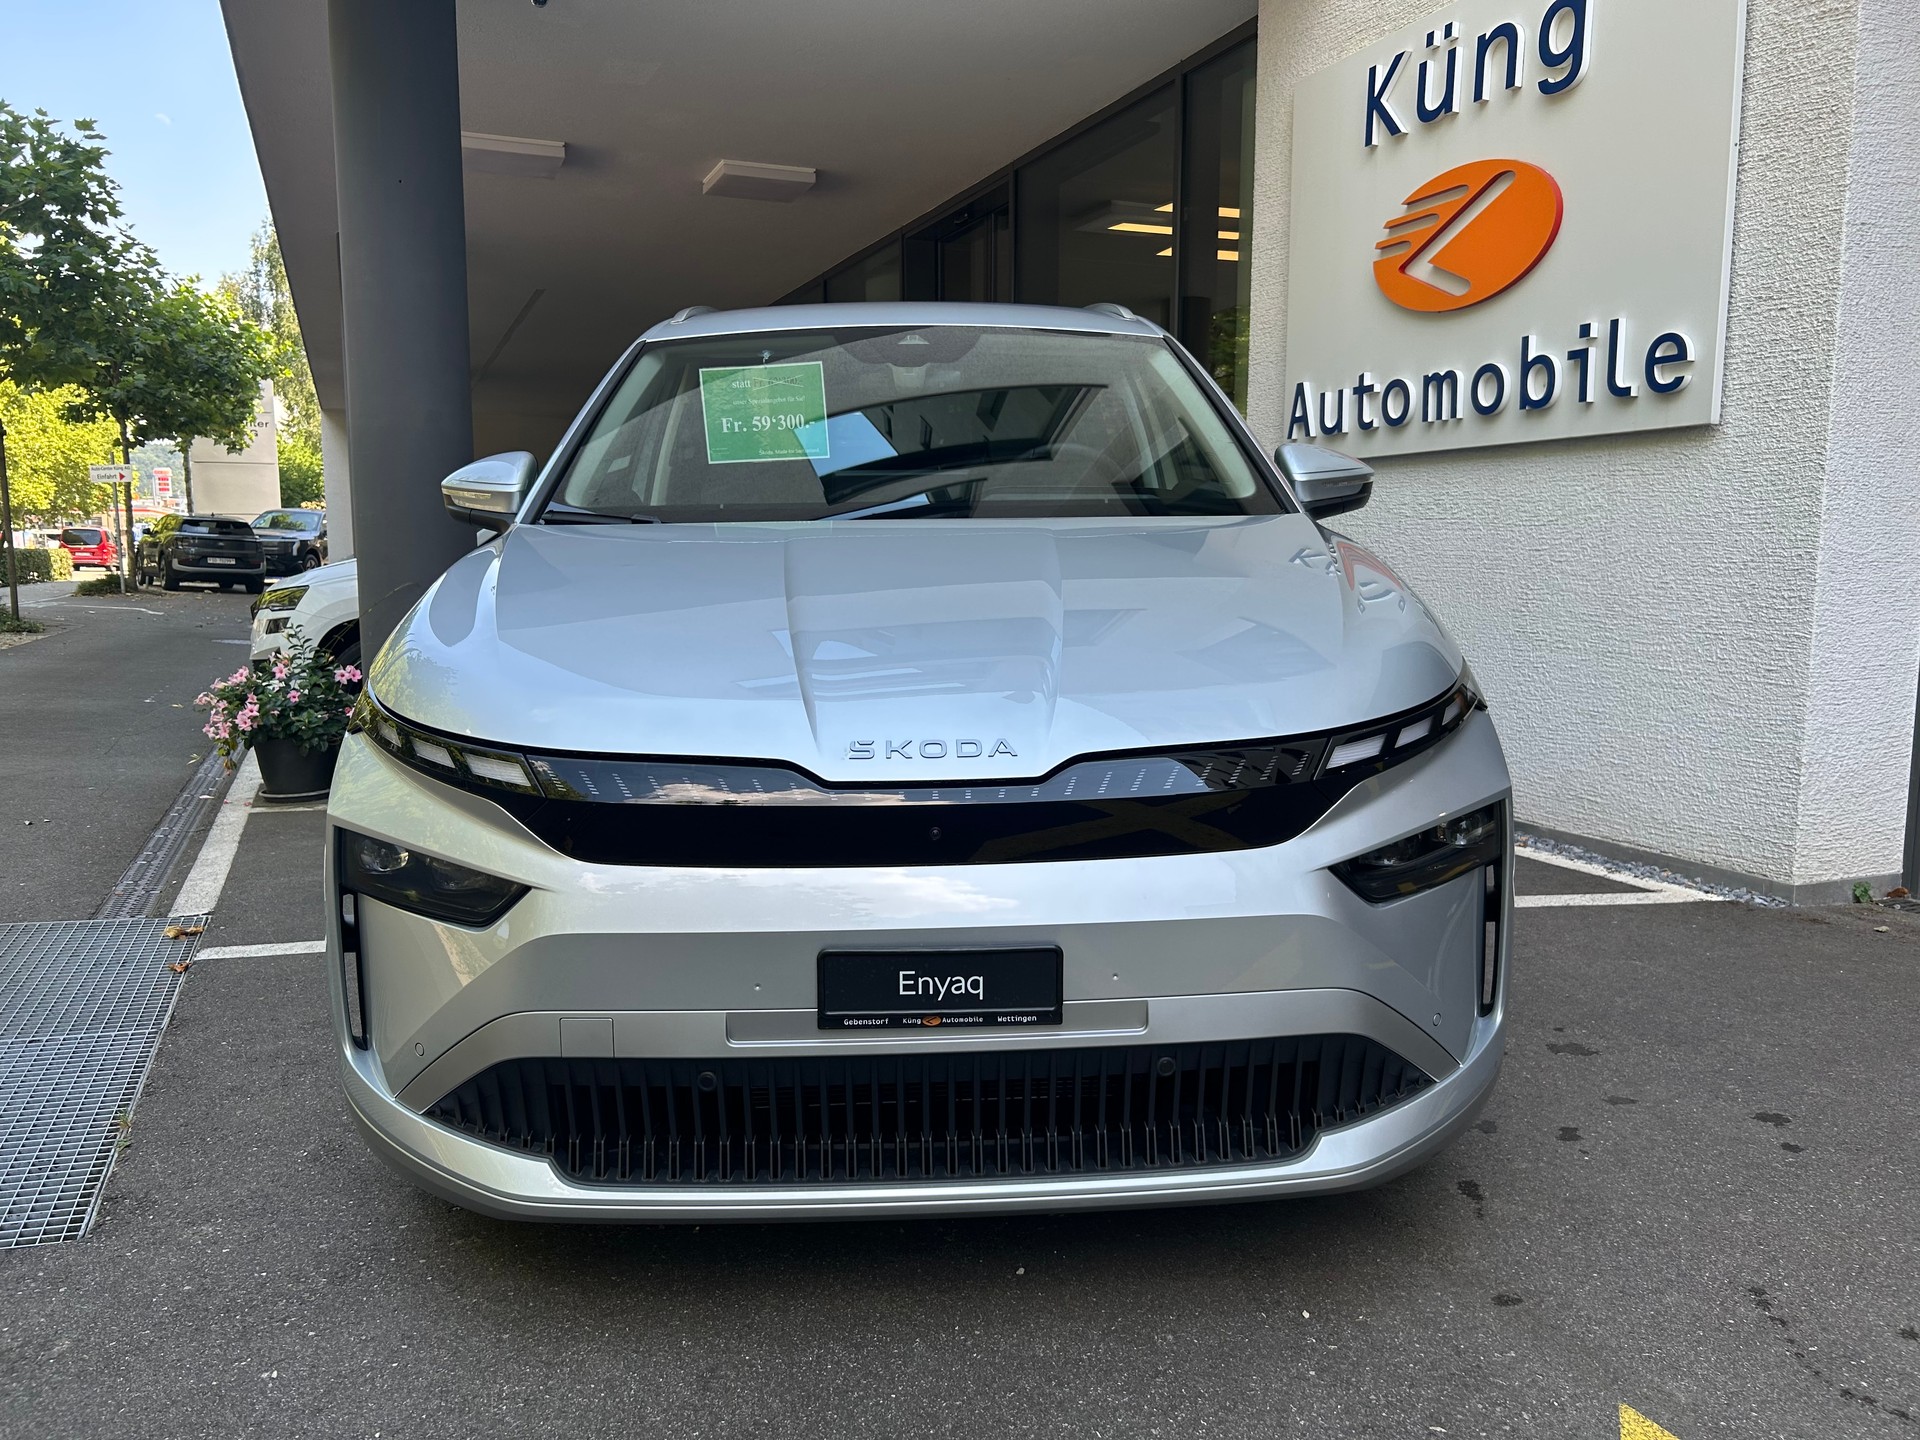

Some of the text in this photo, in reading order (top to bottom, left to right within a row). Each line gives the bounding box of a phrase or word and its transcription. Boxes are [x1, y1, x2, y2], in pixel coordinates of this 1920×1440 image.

[1364, 0, 1589, 148] Küng
[731, 380, 752, 389] statt
[1287, 318, 1694, 440] Automobile
[720, 417, 748, 433] Fr.
[899, 970, 984, 1001] Enyaq
[843, 1014, 1037, 1026] Gebenstorf Küng Automobile Wettingen
